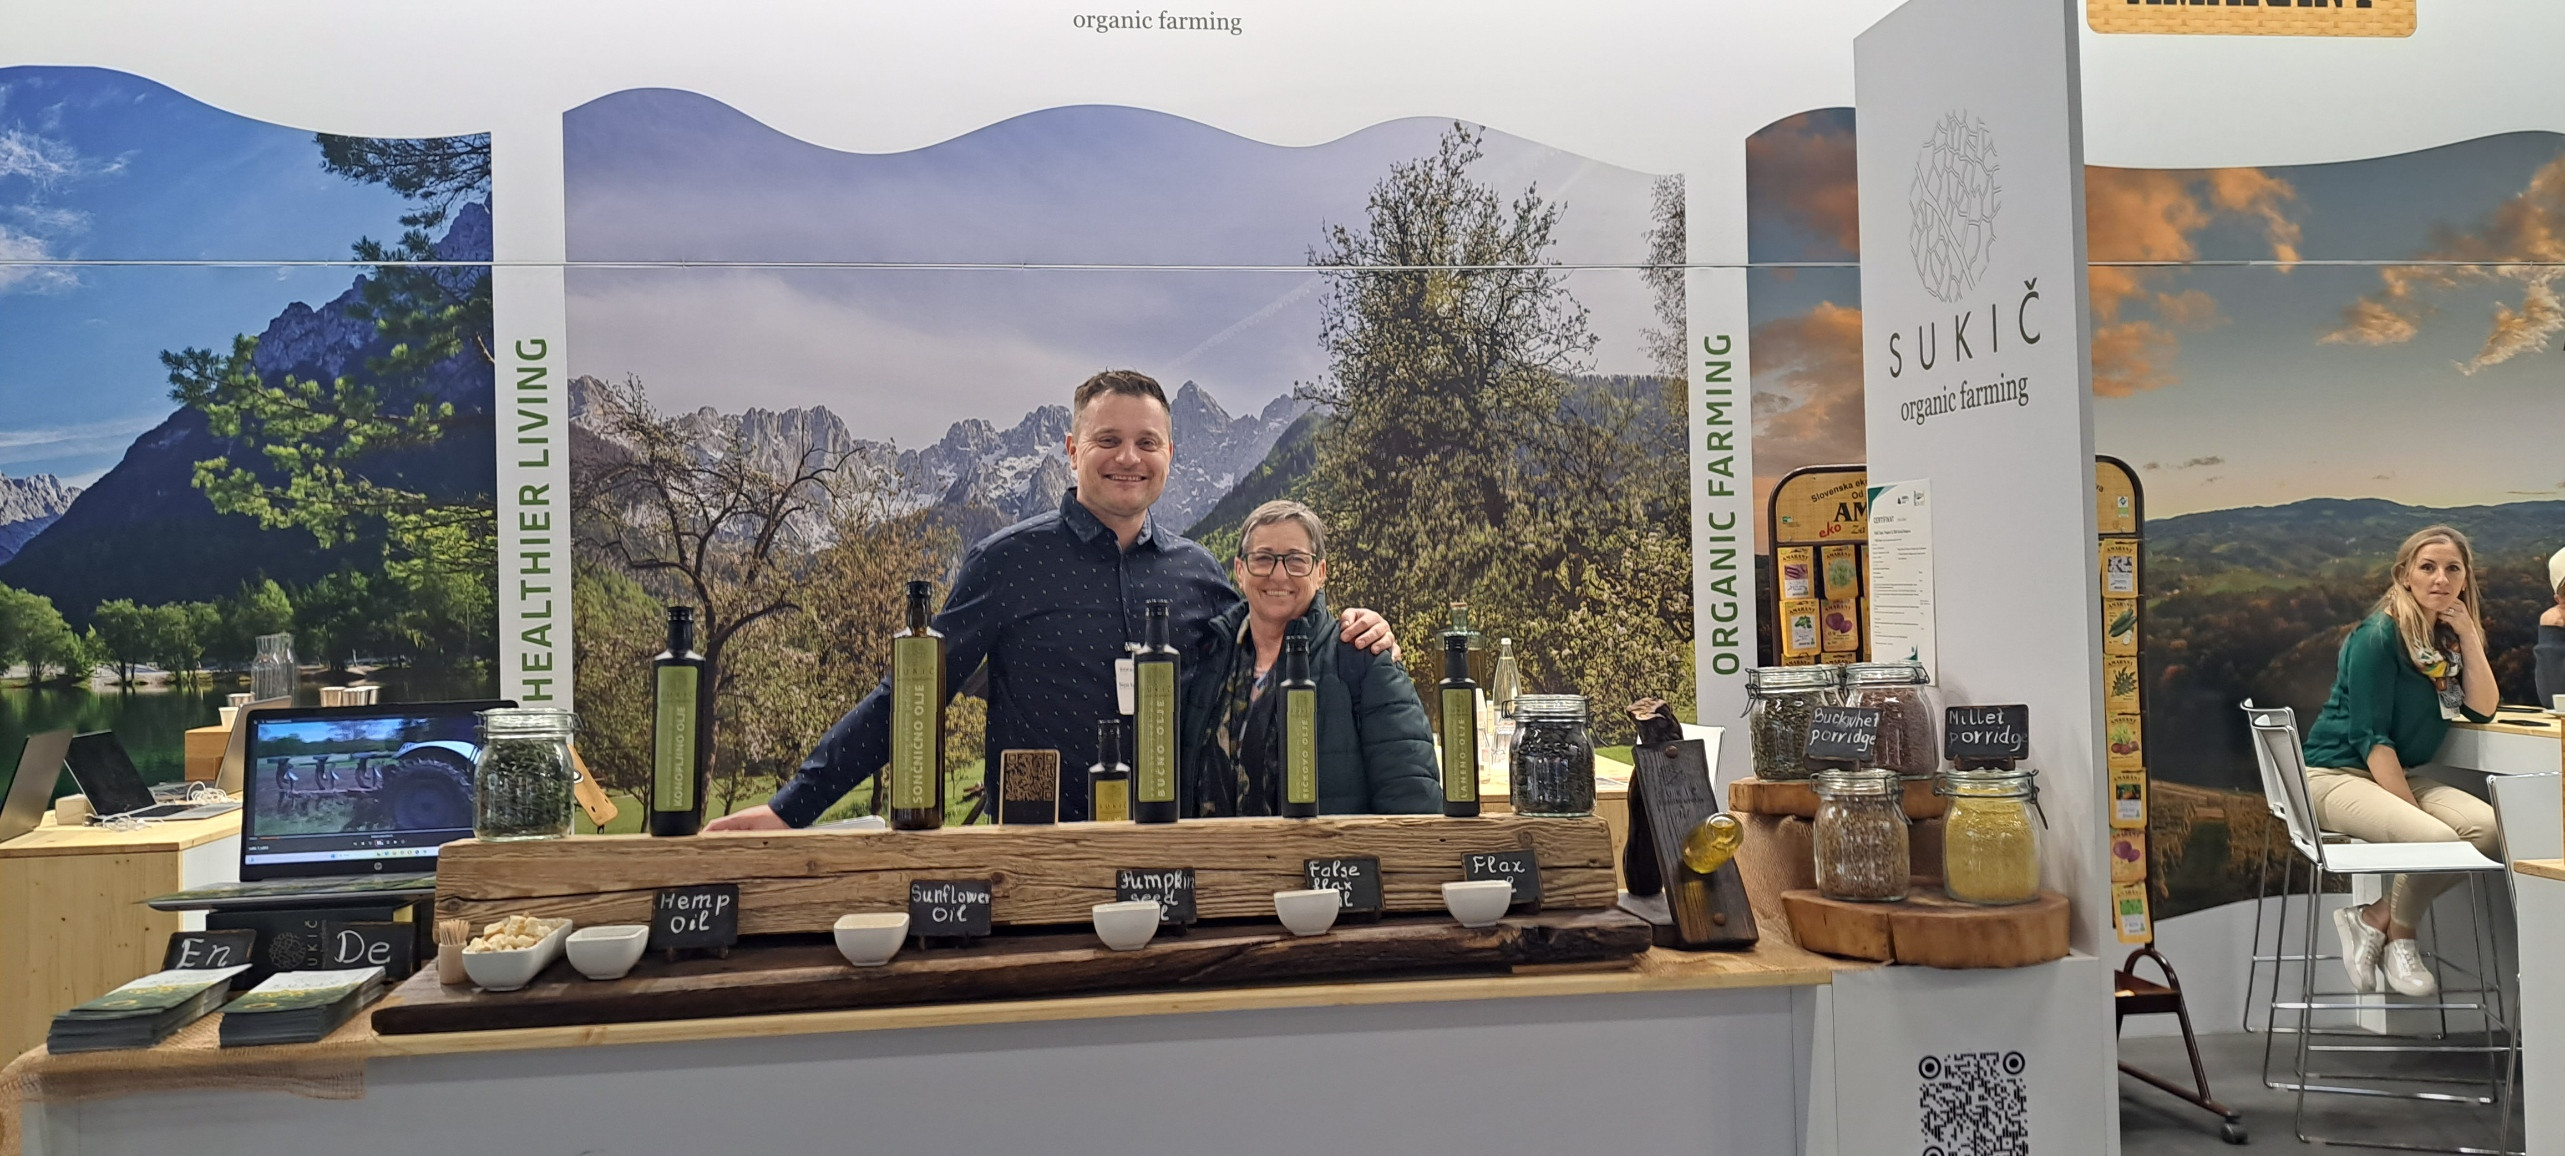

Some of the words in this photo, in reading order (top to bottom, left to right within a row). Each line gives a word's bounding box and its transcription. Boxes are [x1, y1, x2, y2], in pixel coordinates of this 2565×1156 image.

[1073, 10, 1153, 33] organic
[1158, 10, 1242, 36] farming
[1889, 277, 2041, 378] SUKIČ
[515, 338, 549, 467] LIVING
[1901, 385, 1956, 425] organic
[1960, 373, 2029, 407] farming
[1704, 334, 1735, 497] FARMING
[1811, 482, 1854, 503] Slovenska
[1852, 490, 1864, 500] Od
[1819, 521, 1842, 538] eko
[518, 484, 553, 701] HEALTHIER
[1708, 511, 1740, 675] ORGANIC
[914, 684, 925, 717] OLJE
[676, 705, 687, 732] OLJE
[1156, 700, 1165, 736] OLJE
[1949, 707, 2005, 725] Millet
[1458, 718, 1467, 747] OLJE
[1809, 728, 1877, 752] porridge
[1948, 724, 2028, 752] porridge
[1459, 752, 1469, 799] LANENO
[1308, 860, 1361, 878] False
[1472, 855, 1525, 874] Flax
[911, 884, 991, 904] Sunflower
[1121, 869, 1195, 896] Pumpkin
[660, 892, 731, 916] Hemp
[932, 904, 967, 922] Oil
[670, 909, 710, 934] Oil
[175, 937, 231, 969] En
[304, 919, 319, 967] UKIČ
[334, 930, 392, 964] De
